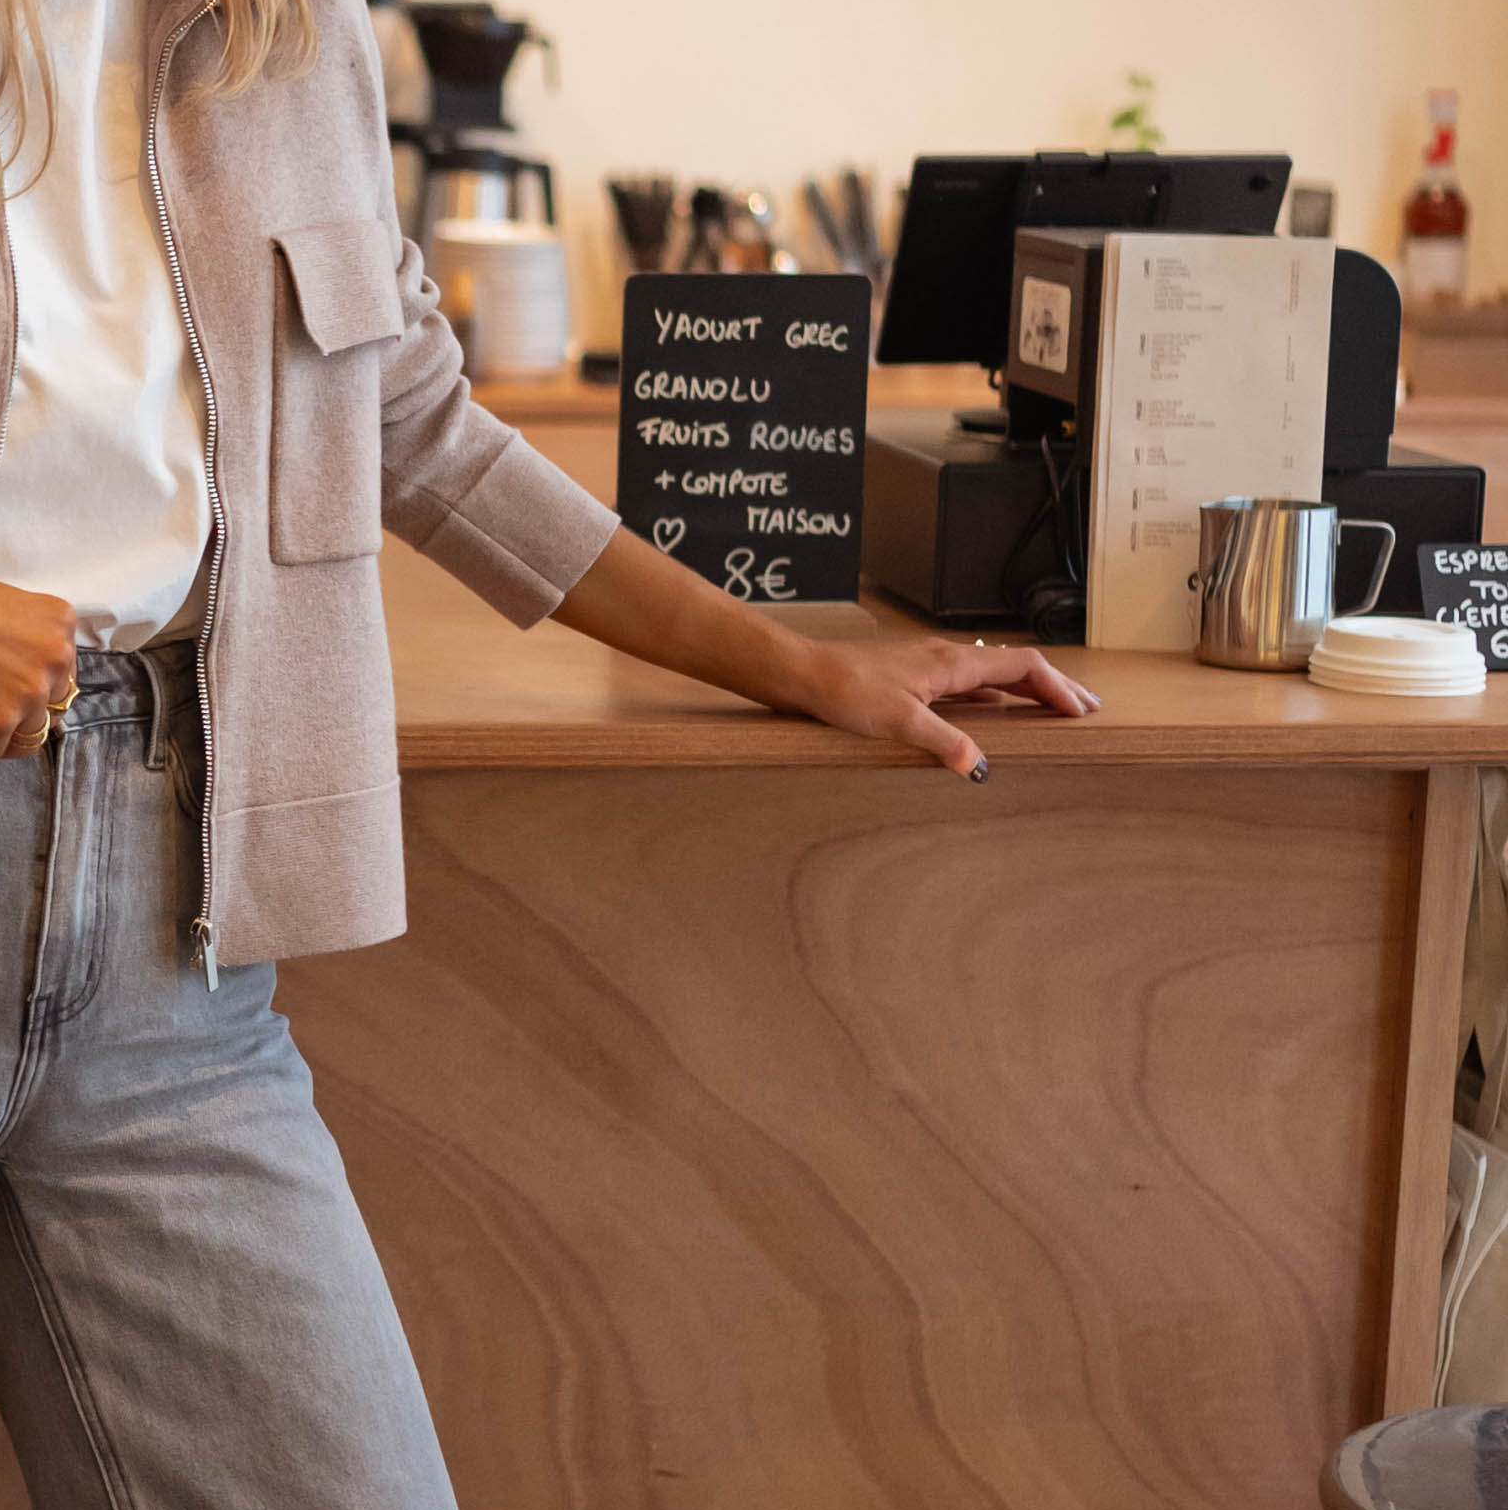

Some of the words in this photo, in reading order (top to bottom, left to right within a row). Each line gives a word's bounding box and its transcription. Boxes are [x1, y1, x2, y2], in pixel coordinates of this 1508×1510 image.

[654, 307, 763, 346] YAOURT
[785, 321, 849, 352] GREC
[749, 421, 856, 455] ROUGES
[681, 469, 789, 498] COMPOTE
[723, 547, 797, 602] 8€
